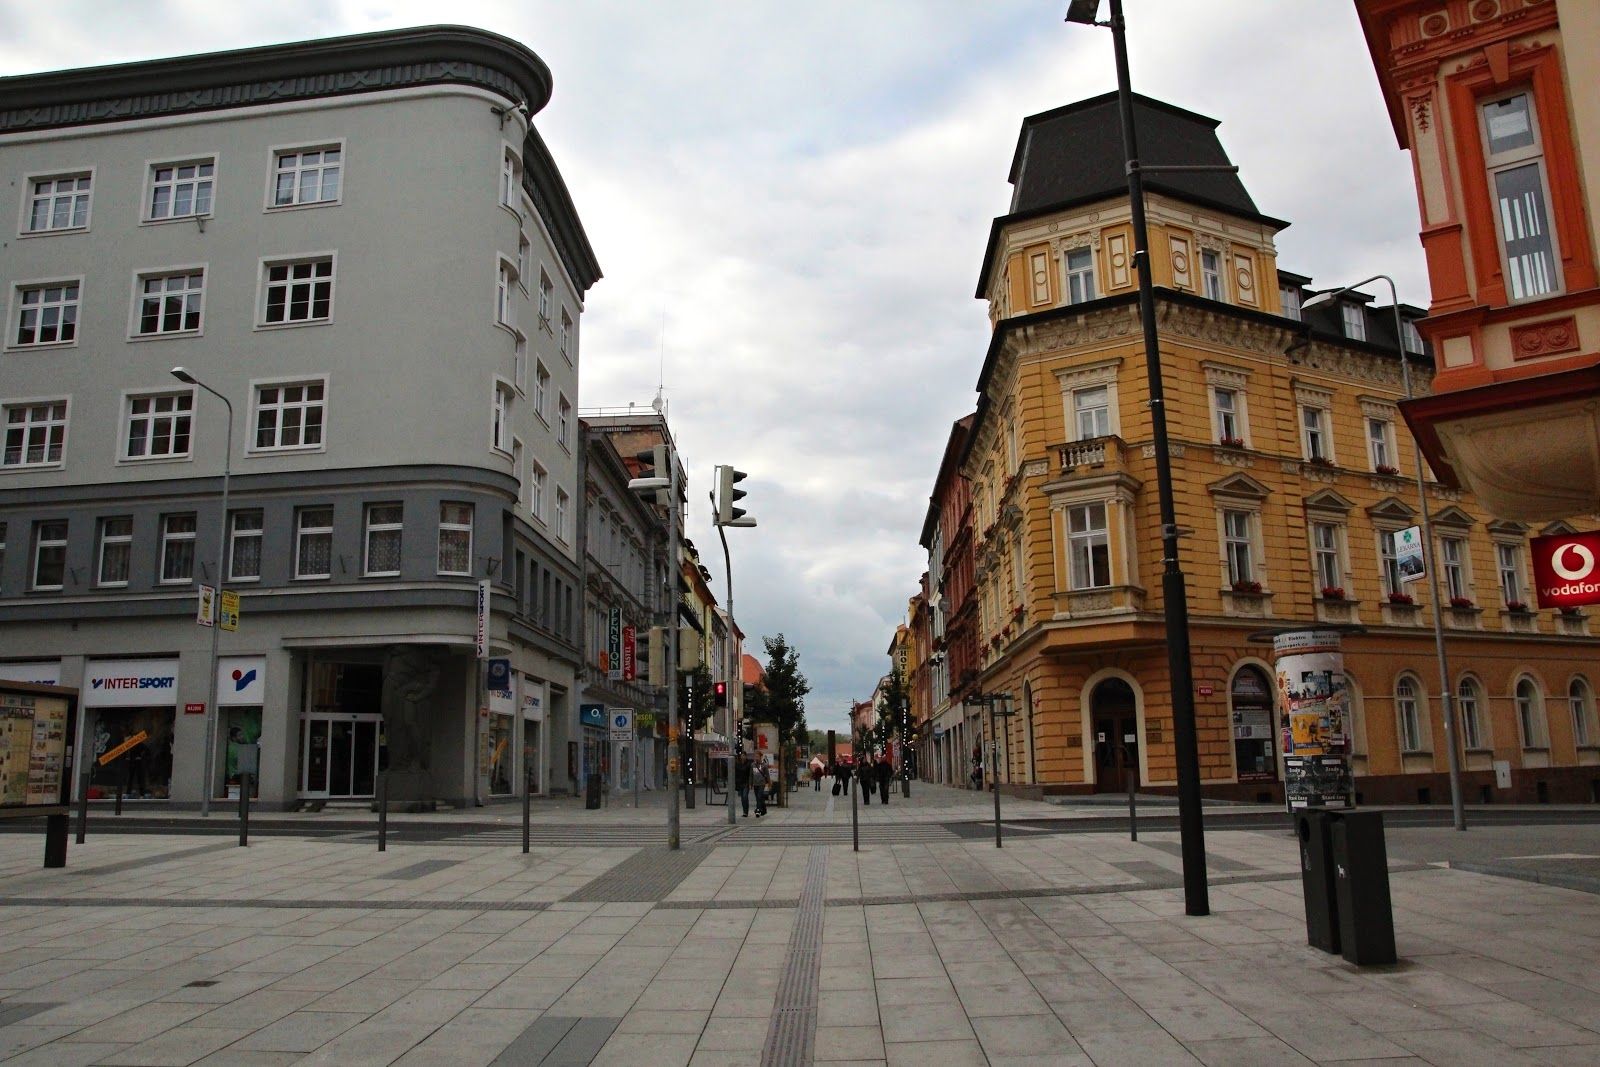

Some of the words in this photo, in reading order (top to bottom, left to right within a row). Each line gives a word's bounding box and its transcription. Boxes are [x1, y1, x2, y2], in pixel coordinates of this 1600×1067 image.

[610, 608, 619, 670] PENSION
[104, 677, 174, 689] INTERSPORT
[900, 650, 908, 684] HOTEL
